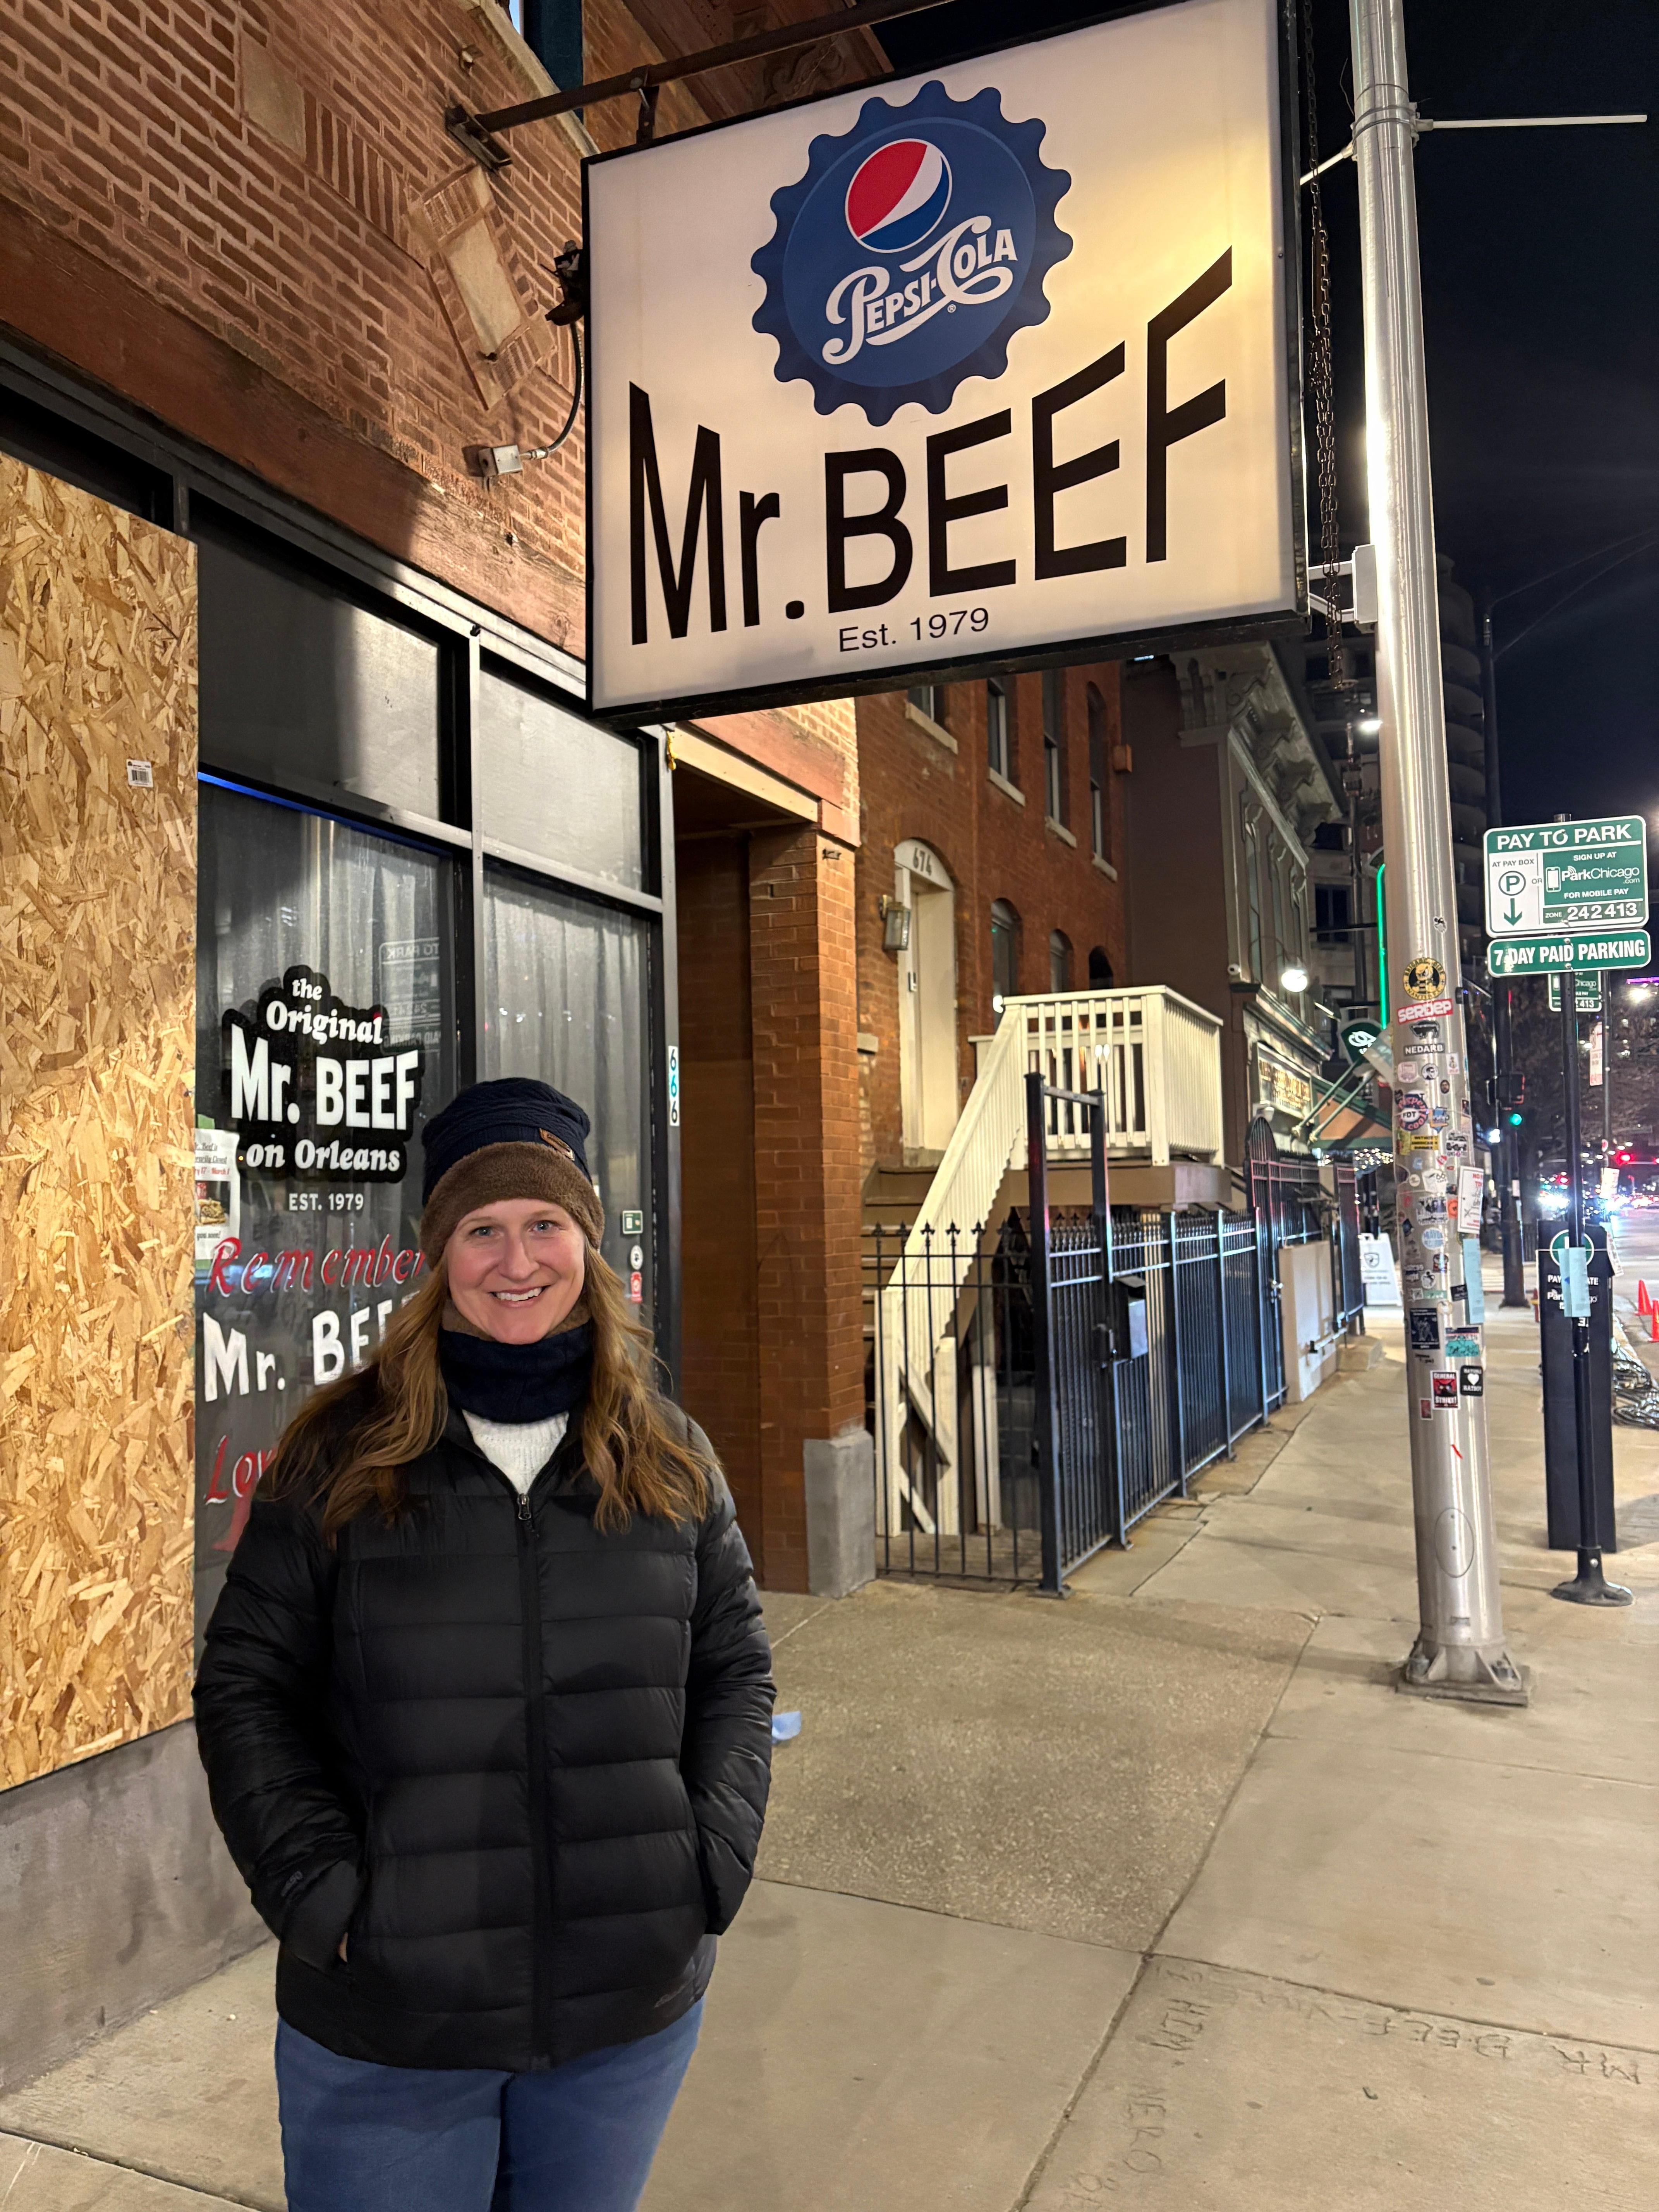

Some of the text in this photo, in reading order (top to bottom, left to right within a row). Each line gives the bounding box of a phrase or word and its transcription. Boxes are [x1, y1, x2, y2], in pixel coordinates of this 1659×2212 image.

[629, 245, 1232, 645] Mr. BEEF
[840, 608, 988, 652] Est. 1979
[1497, 824, 1632, 850] PAY TO PARK
[1561, 867, 1640, 881] ParkChicago
[1582, 889, 1612, 898] MOBILE
[1494, 939, 1645, 966] 7 DAY PAID PARKING
[292, 978, 322, 1000] the
[266, 1000, 383, 1045] Original
[1405, 1044, 1444, 1054] NEDARB
[232, 1023, 419, 1130] Mr. BEEF
[669, 1049, 677, 1123] 666
[246, 1139, 400, 1171] on Orleans
[289, 1192, 364, 1211] EST. 1979
[206, 1233, 425, 1297] Remember
[203, 1312, 286, 1402] Mr.
